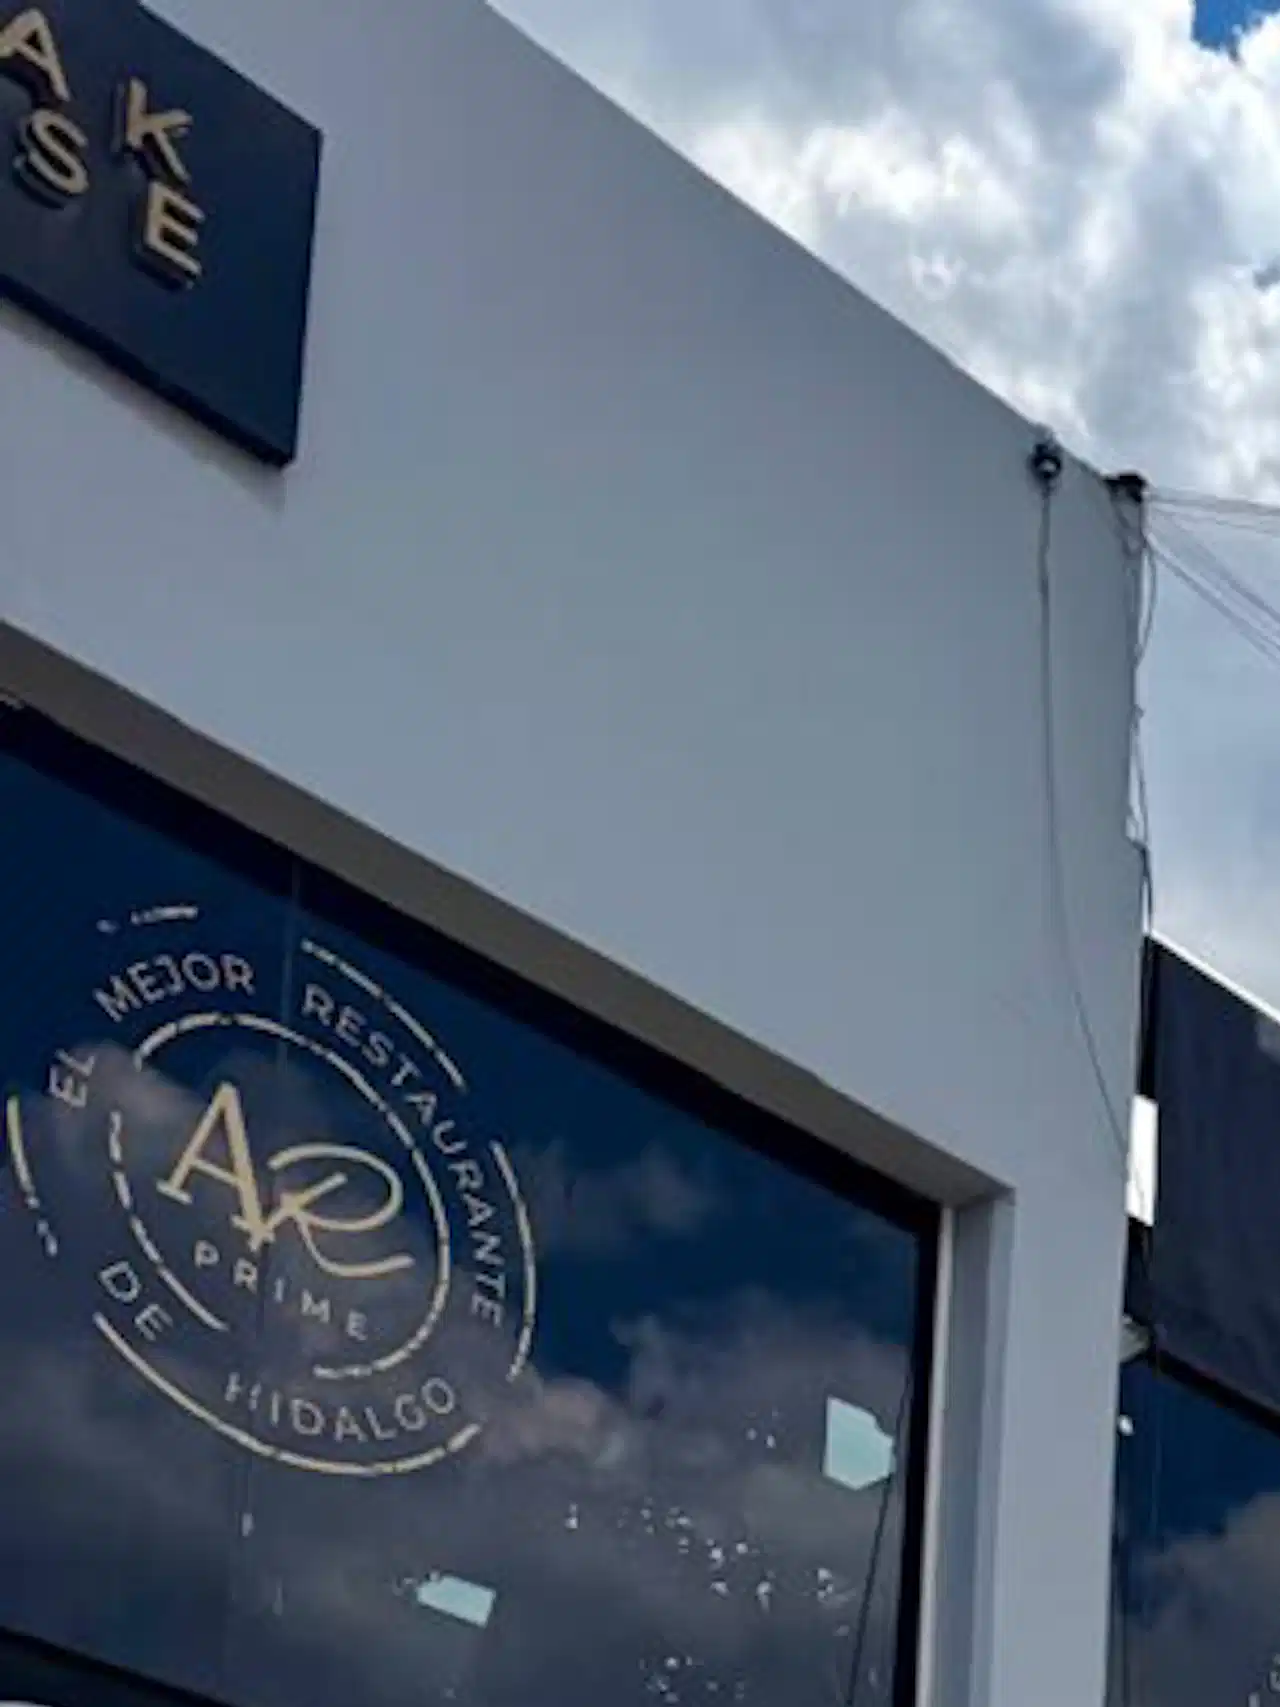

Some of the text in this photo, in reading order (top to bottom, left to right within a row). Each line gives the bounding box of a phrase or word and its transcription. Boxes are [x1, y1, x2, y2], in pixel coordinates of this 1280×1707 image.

[49, 953, 502, 1328] EL MEJOR RESTAURANTE
[99, 1260, 455, 1443] DE HIDALGO
[194, 1241, 367, 1340] PRIME
